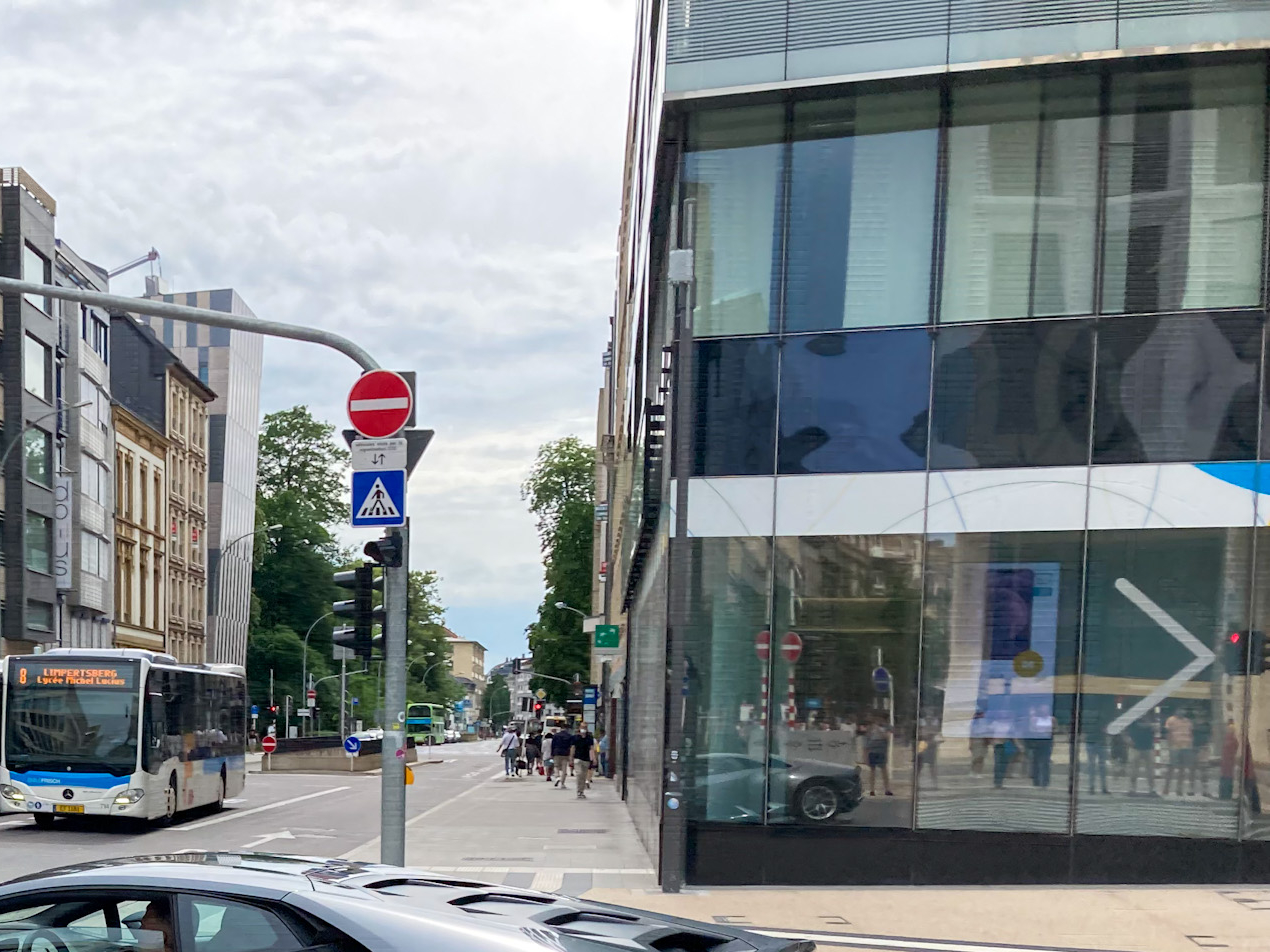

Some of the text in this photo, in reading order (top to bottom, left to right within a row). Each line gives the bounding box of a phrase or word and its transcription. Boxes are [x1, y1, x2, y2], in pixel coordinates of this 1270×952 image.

[19, 668, 28, 685] 8
[43, 668, 118, 678] LIMPERTSBERG
[37, 675, 126, 686] Lycée Michel Lucius
